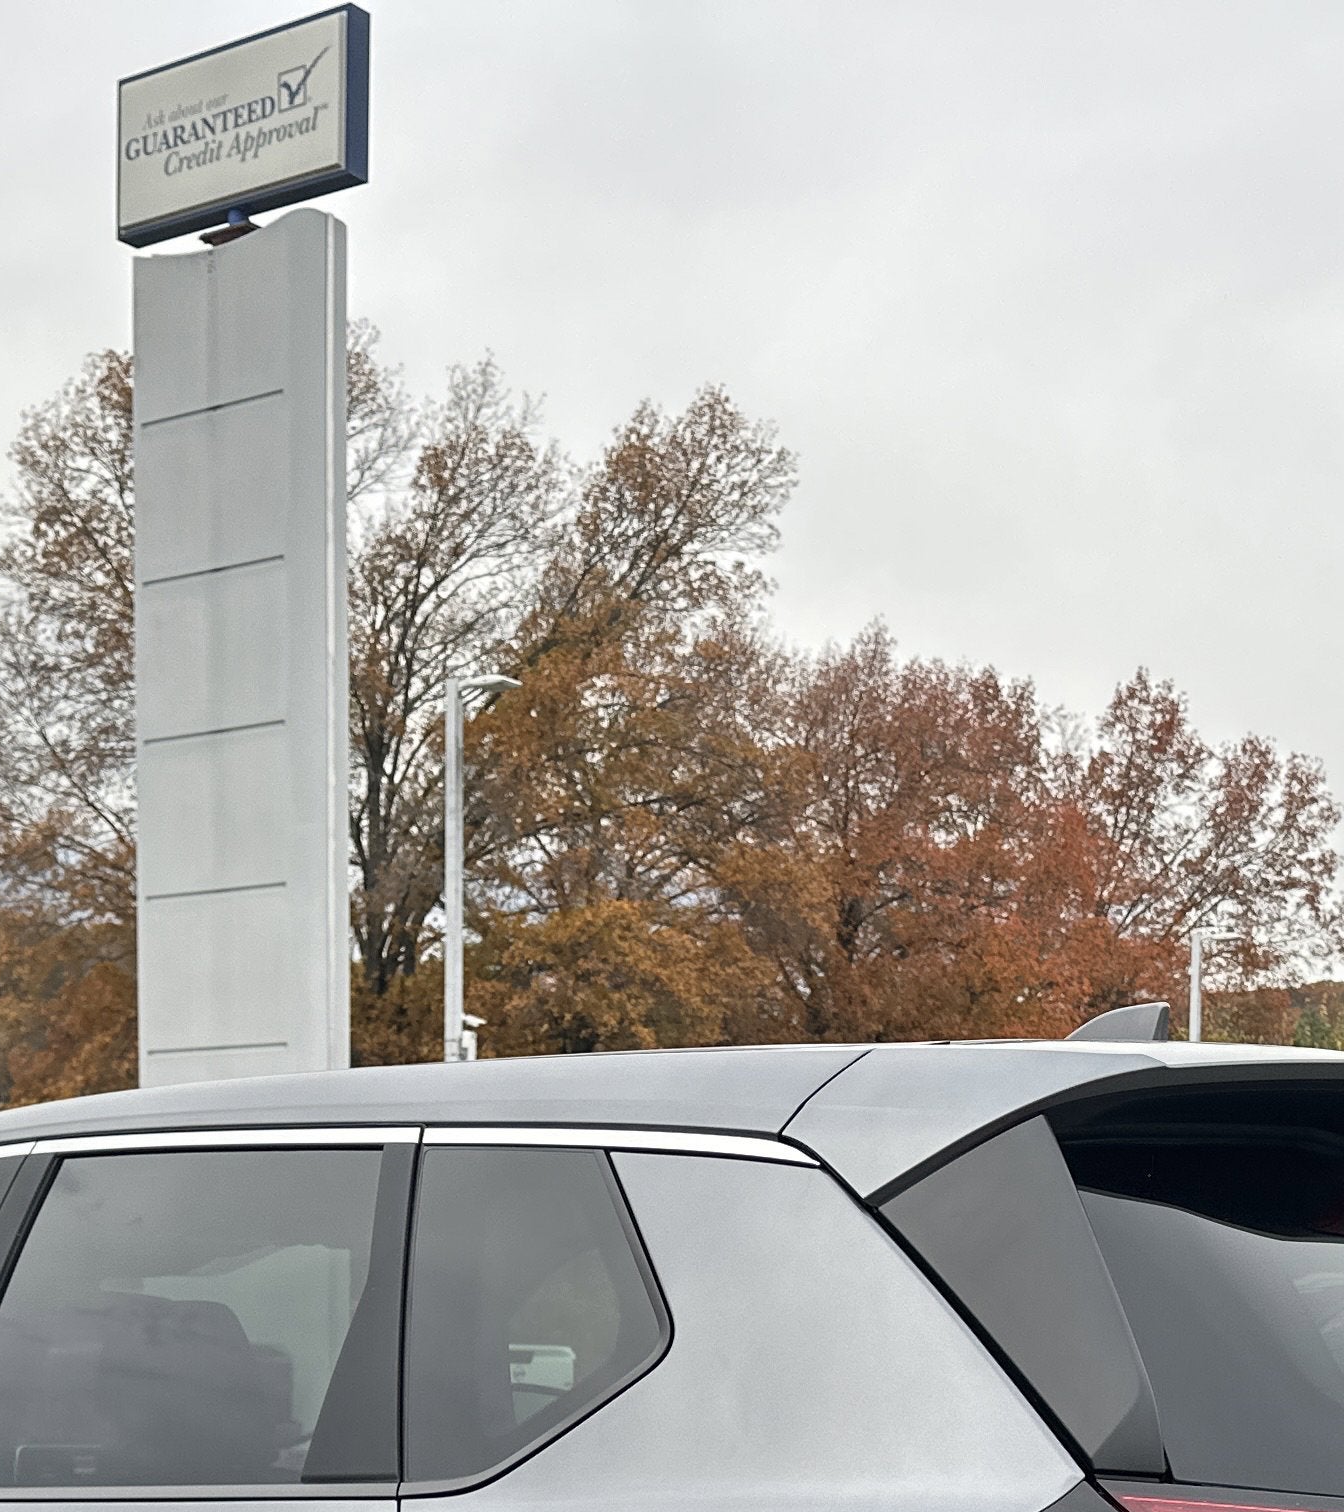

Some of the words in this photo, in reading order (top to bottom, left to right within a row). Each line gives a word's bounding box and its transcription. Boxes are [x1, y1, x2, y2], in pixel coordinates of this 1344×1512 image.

[125, 96, 276, 161] GUARANTEED
[143, 109, 166, 130] Ask
[168, 100, 203, 122] about
[163, 140, 223, 177] Credit
[226, 106, 320, 162] Approval
